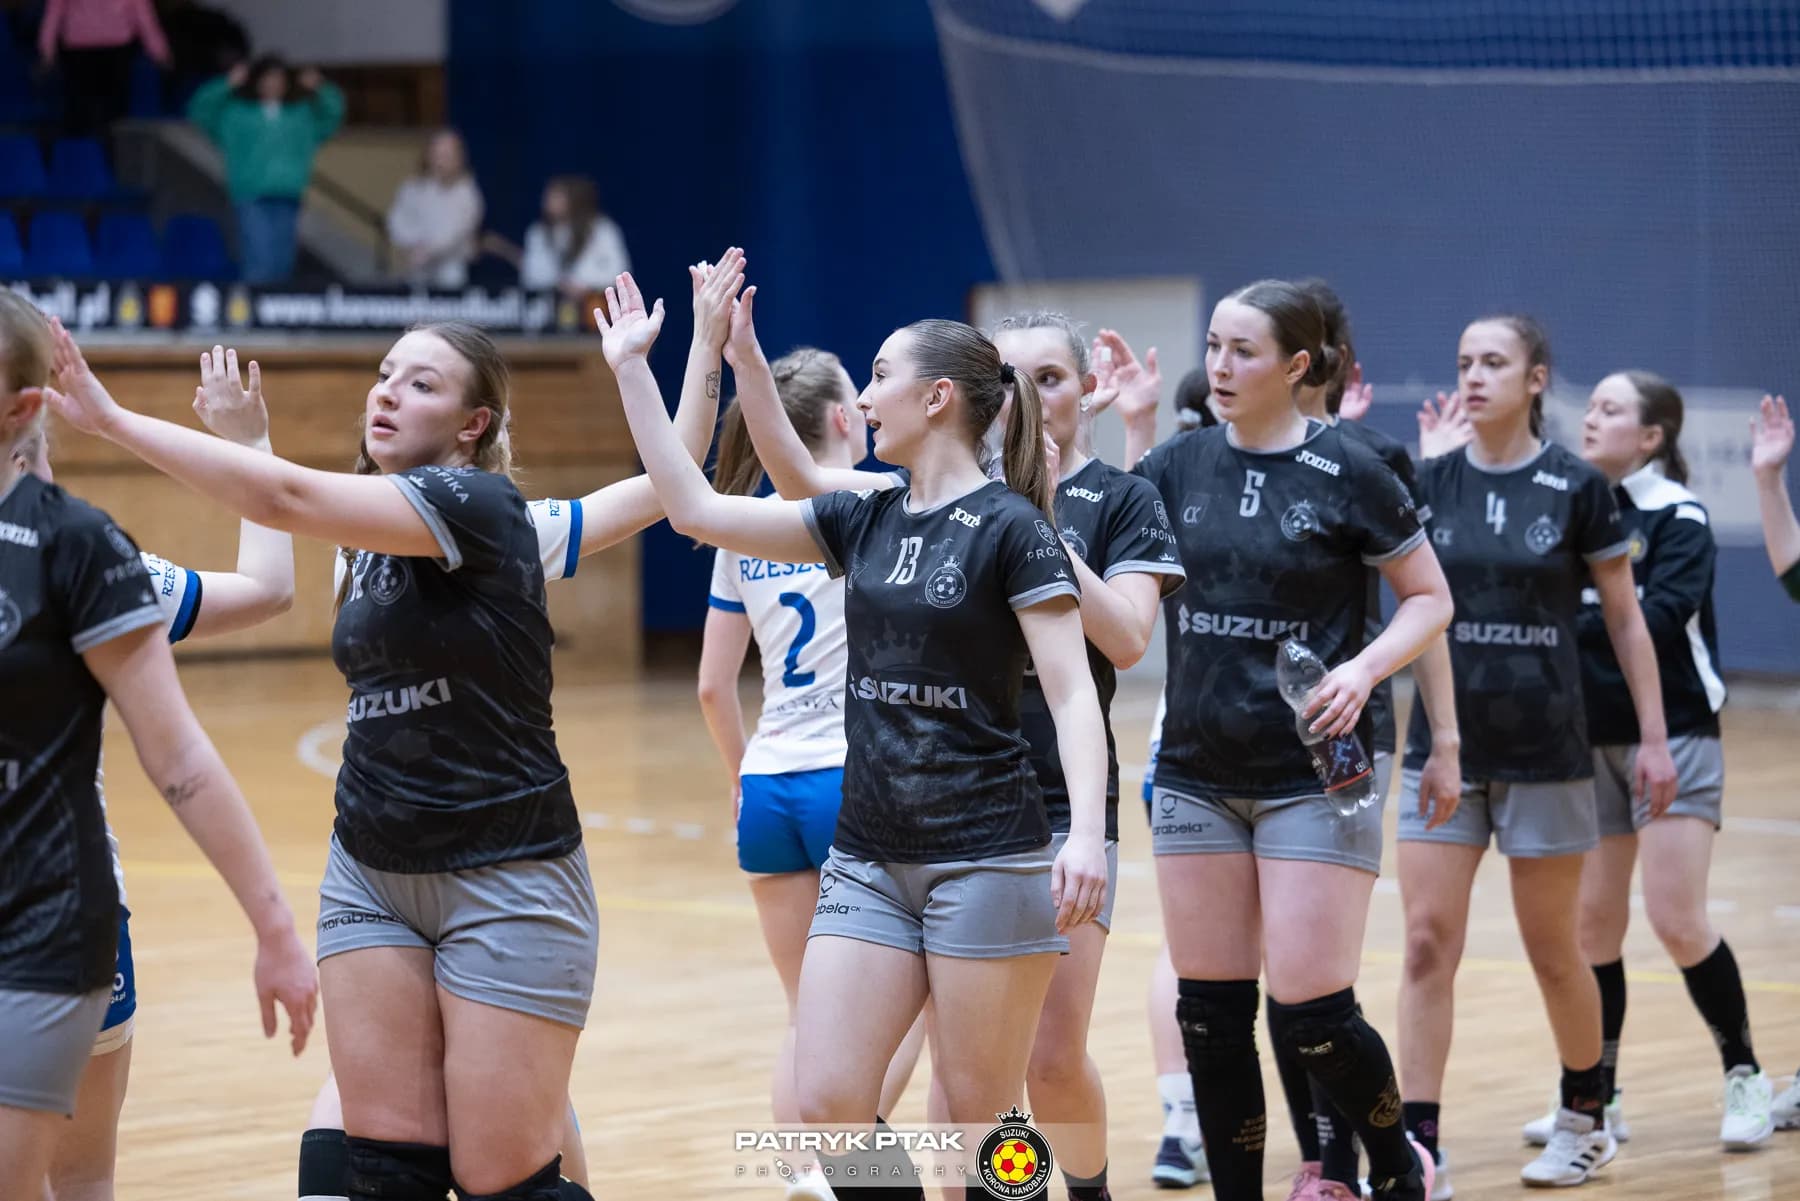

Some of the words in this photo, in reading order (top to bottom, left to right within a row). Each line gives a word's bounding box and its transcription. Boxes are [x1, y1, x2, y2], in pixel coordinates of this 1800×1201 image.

[425, 466, 470, 504] OFIKA
[1239, 469, 1266, 517] 5
[1486, 492, 1505, 534] 4
[885, 536, 923, 584] 13
[779, 592, 816, 688] 2
[1192, 611, 1309, 641] SUZUKI
[1455, 621, 1559, 647] SUZUKI
[859, 676, 967, 709] SUZUKI
